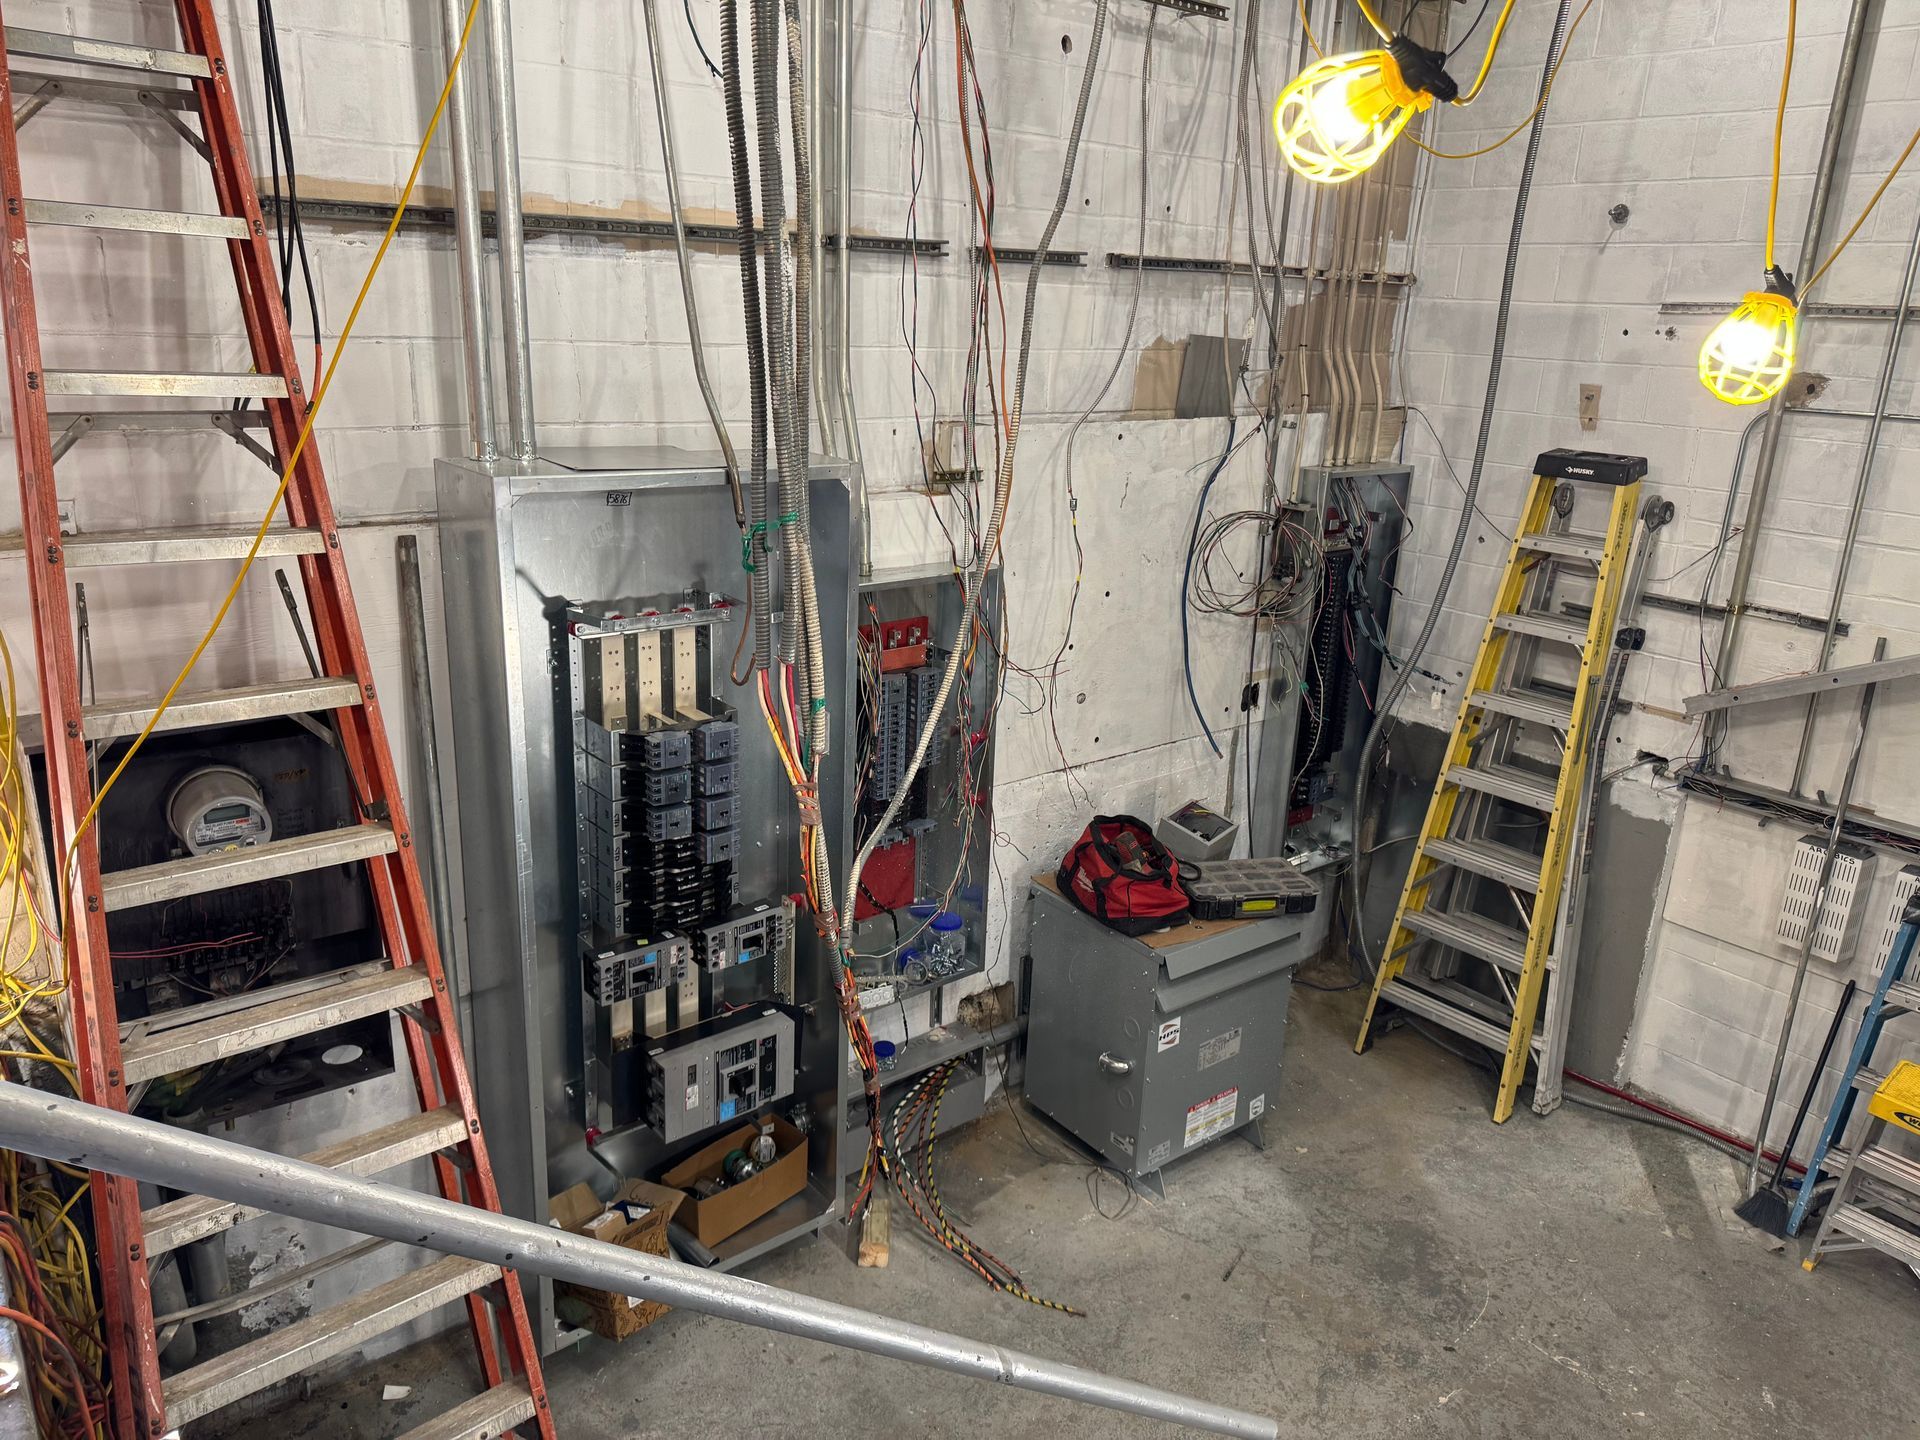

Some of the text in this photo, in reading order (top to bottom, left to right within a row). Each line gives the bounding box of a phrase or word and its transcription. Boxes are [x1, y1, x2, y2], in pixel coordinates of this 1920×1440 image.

[1573, 467, 1595, 476] HUSKY
[1618, 501, 1628, 539] HUSKY
[1596, 610, 1606, 647] HUSKY
[1535, 925, 1545, 962] HUSKY
[1159, 1028, 1180, 1041] HPS
